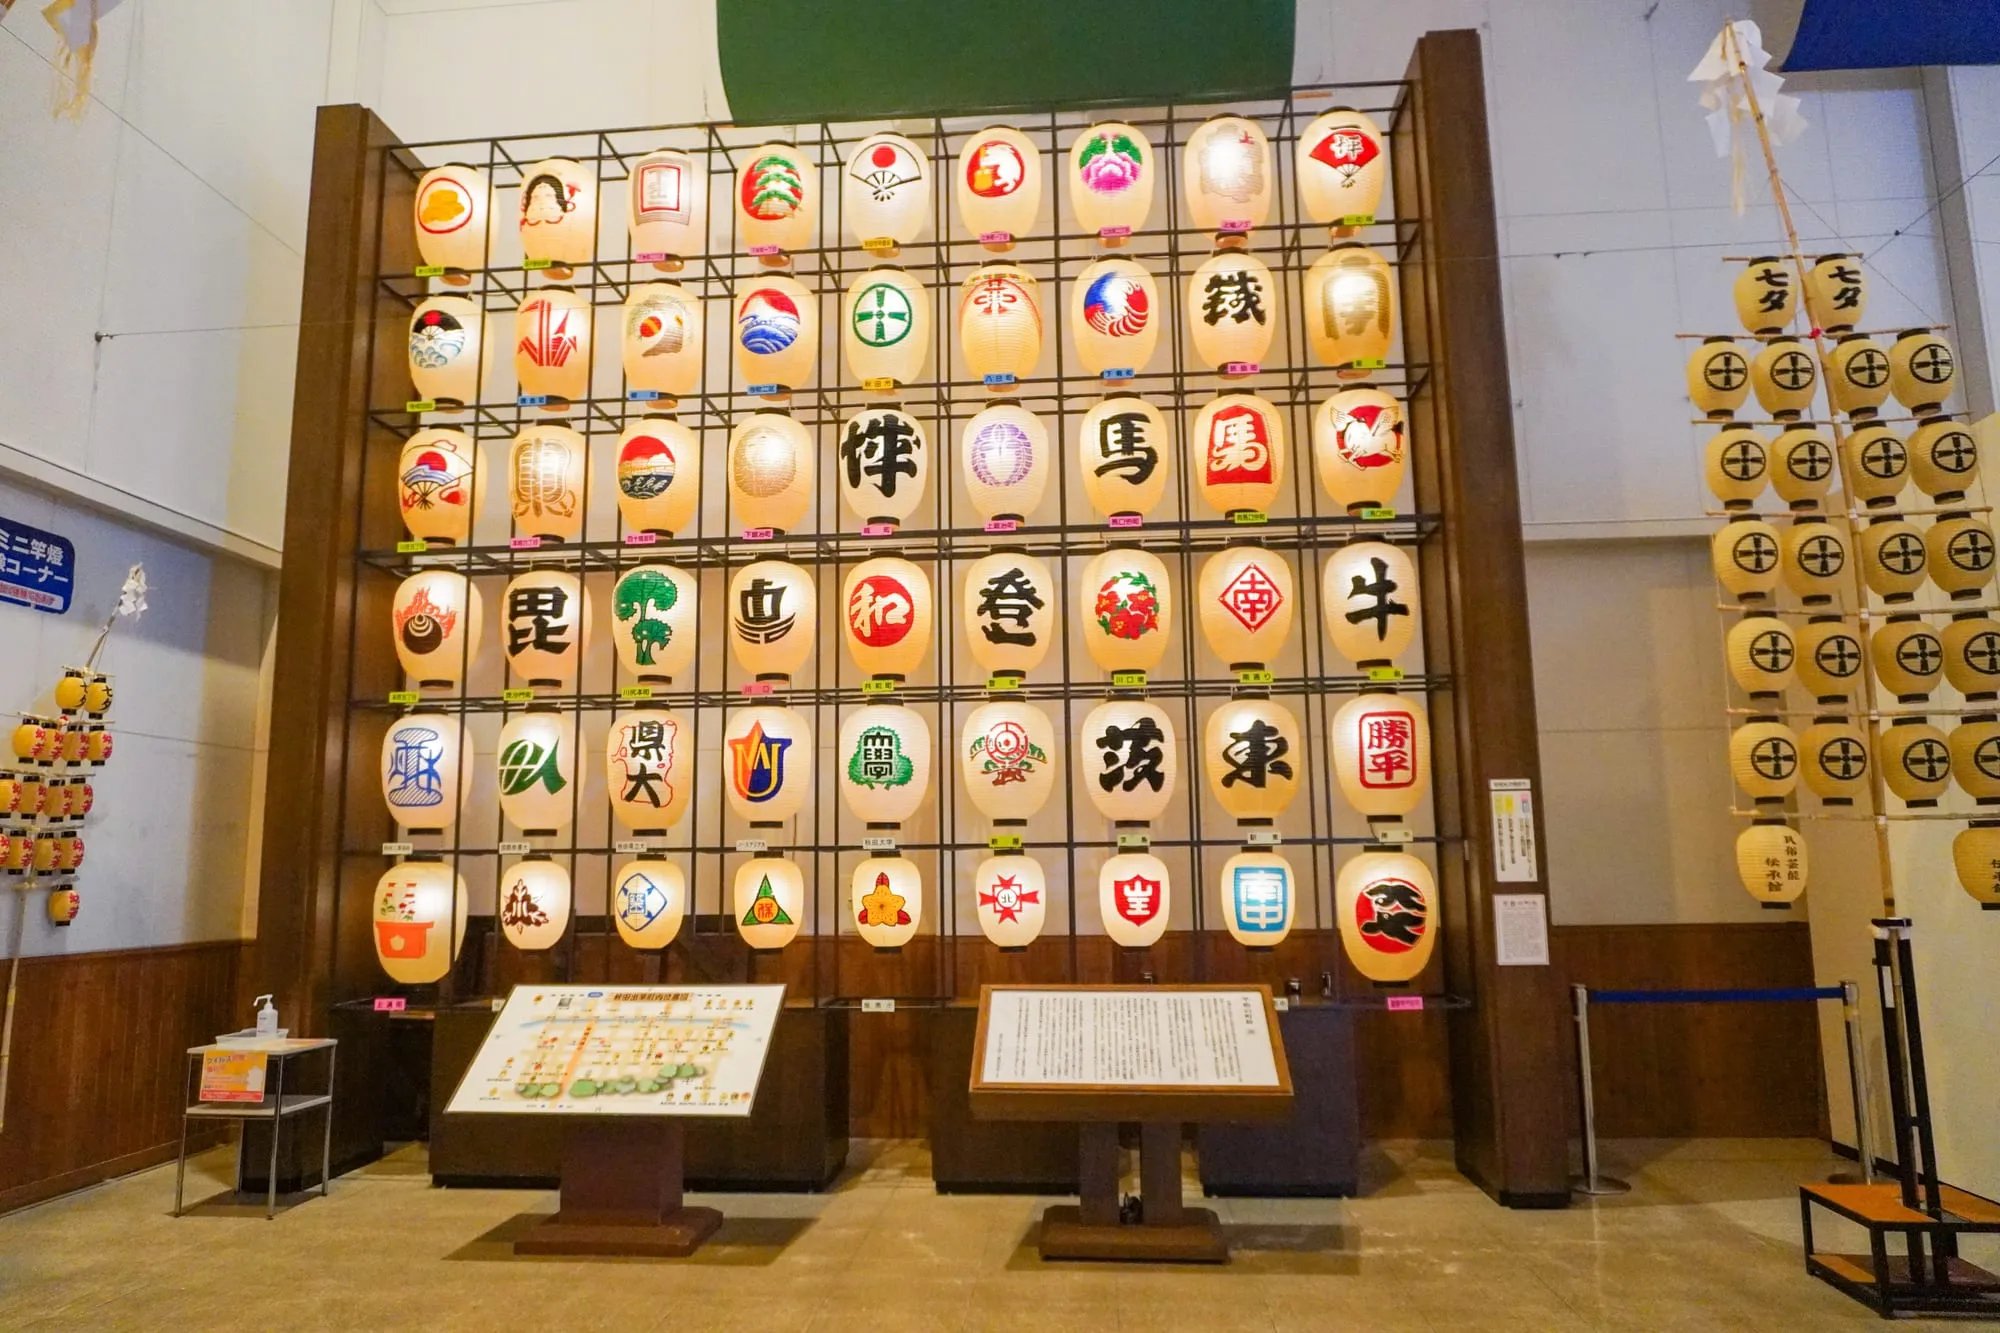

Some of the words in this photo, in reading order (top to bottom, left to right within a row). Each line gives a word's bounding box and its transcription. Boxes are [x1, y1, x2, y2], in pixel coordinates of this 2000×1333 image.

[1755, 268, 1789, 313] 七夕
[1828, 265, 1862, 310] 七夕
[1093, 412, 1158, 485] 馬
[1208, 412, 1267, 472] 馬
[508, 586, 571, 656] 毘
[849, 584, 908, 638] 和
[977, 567, 1045, 647] 登
[1234, 574, 1272, 621] 南
[1345, 557, 1410, 642] 牛
[624, 720, 666, 808] 県大
[1221, 720, 1294, 789] 東
[1368, 719, 1410, 781] 勝平
[1765, 857, 1783, 892] 伝承館
[1784, 835, 1800, 881] 民俗芸能
